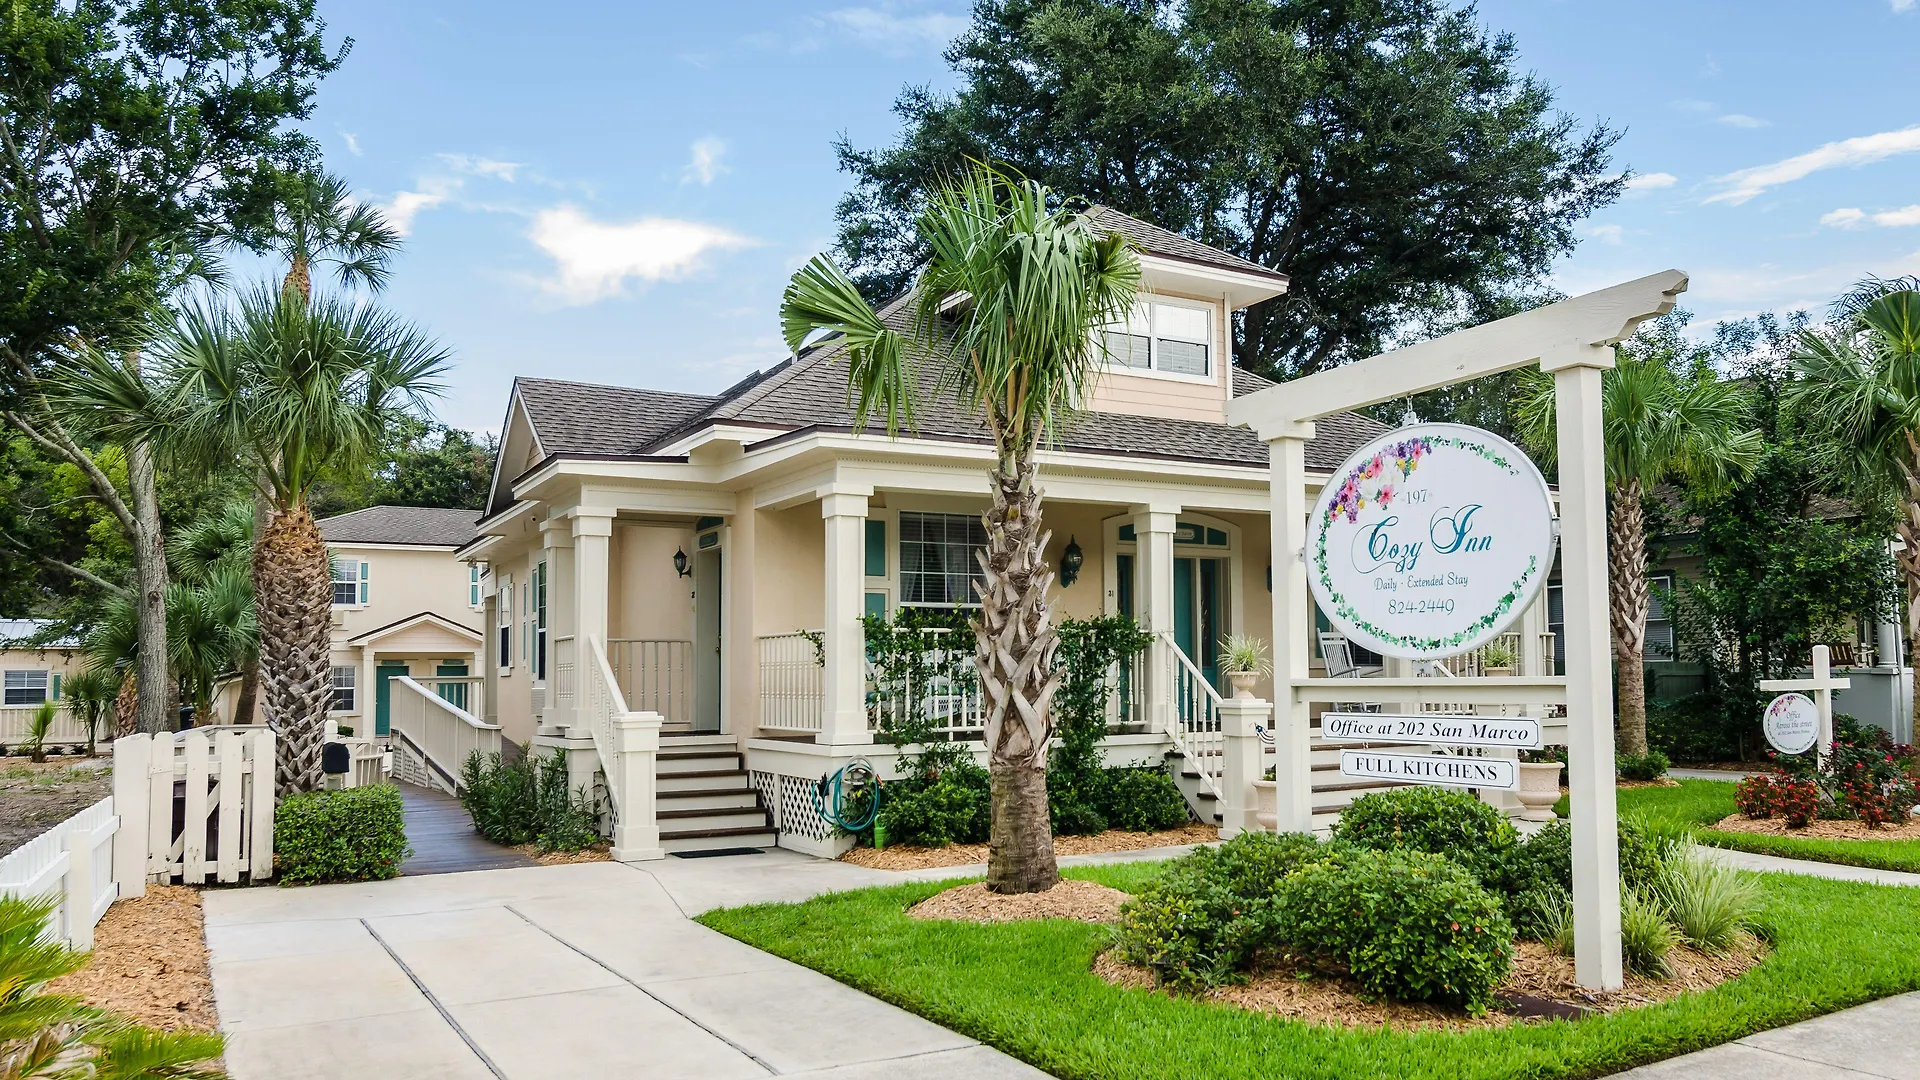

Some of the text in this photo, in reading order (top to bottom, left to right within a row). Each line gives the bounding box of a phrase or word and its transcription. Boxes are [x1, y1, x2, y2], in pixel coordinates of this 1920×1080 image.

[1407, 489, 1427, 504] 197
[1351, 504, 1492, 574] Cozy Inn
[1374, 577, 1397, 591] Daily
[1407, 574, 1444, 588] Extended
[1447, 571, 1468, 587] Stay
[1388, 598, 1455, 616] 824-2449
[1330, 719, 1529, 740] Office at 202 San Marco
[1356, 757, 1498, 780] FULL KITCHENS
